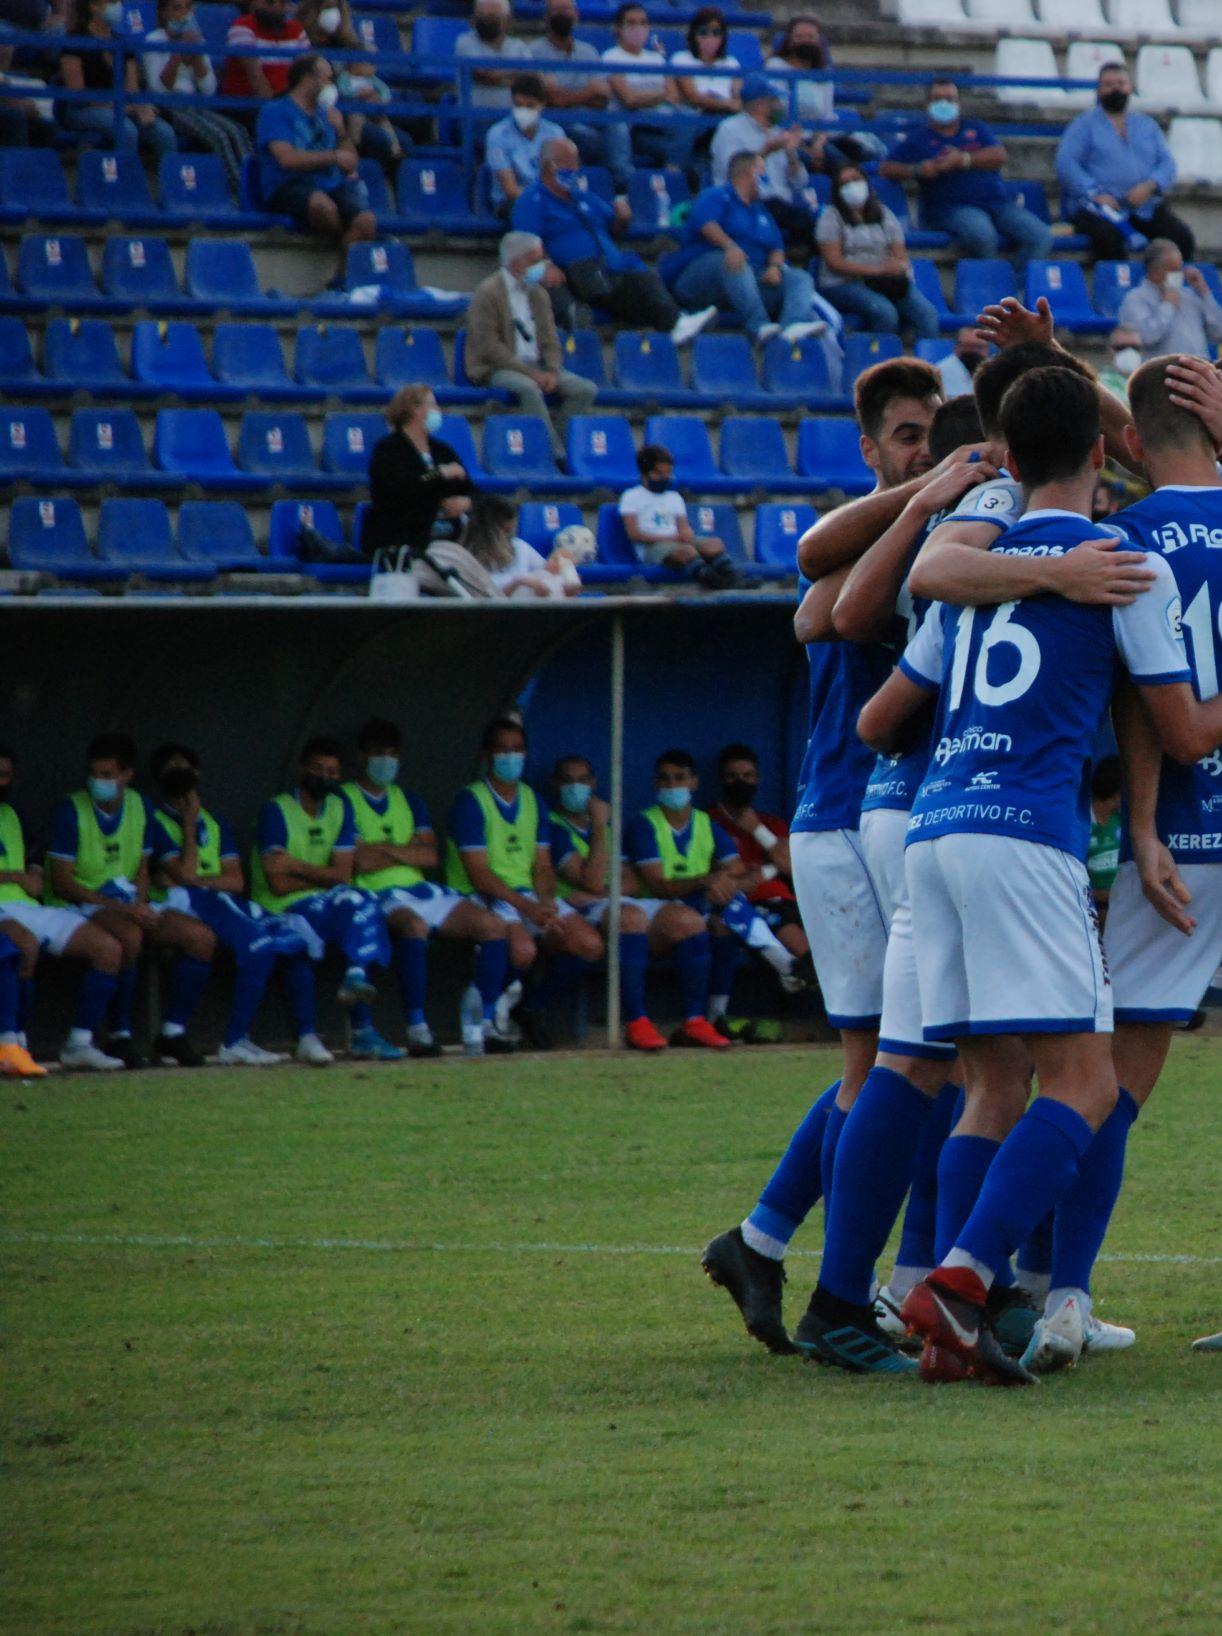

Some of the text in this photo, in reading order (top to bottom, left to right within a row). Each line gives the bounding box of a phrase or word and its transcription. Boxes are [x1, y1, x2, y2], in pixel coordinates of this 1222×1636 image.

[949, 600, 1041, 711] 16
[924, 804, 1001, 826] DEPORTIVO
[1004, 807, 1034, 825] F.C.
[1168, 832, 1222, 850] XEREZ
